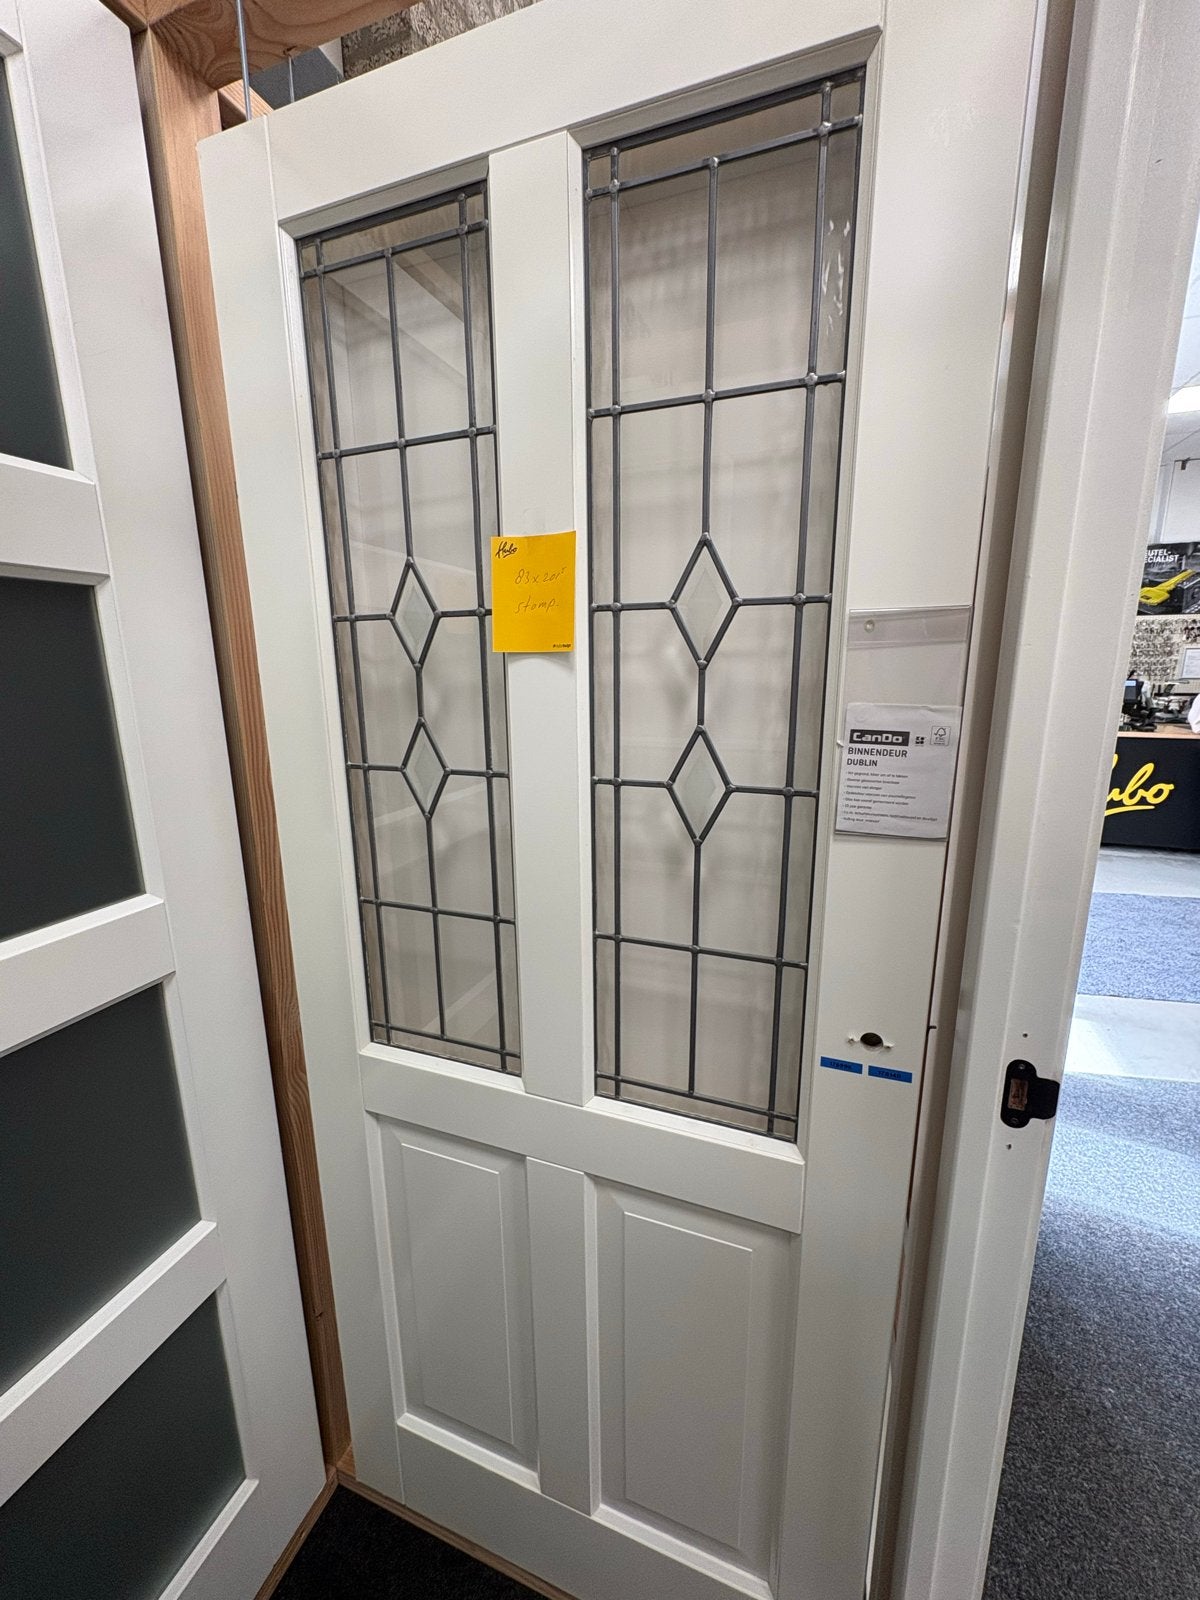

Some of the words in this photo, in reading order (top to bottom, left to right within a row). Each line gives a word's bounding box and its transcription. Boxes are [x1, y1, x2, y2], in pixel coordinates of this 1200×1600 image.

[495, 541, 518, 558] Hubo
[852, 732, 903, 744] CanDo
[847, 746, 908, 758] BINNENDEUR
[846, 758, 878, 767] DUBLIN
